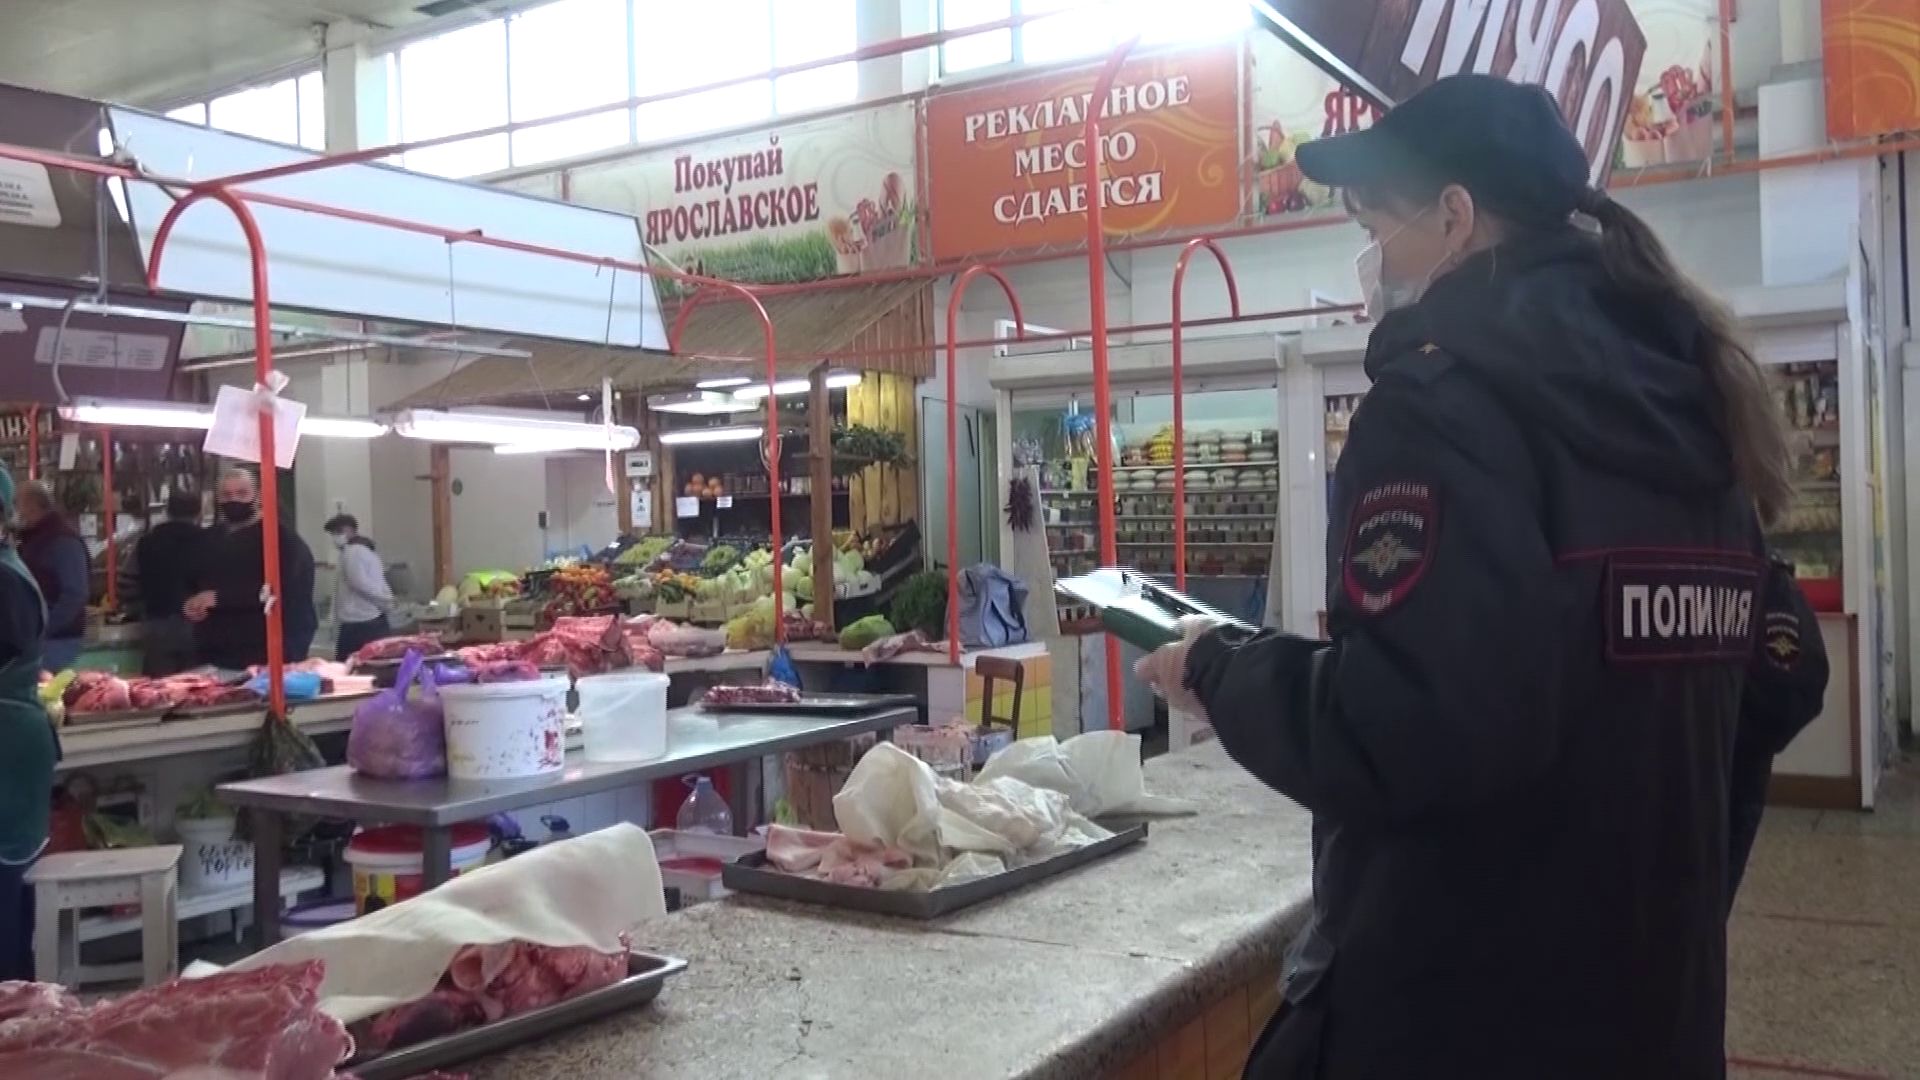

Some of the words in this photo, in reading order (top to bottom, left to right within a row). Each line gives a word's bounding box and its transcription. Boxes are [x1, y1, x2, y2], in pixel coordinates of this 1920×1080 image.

[674, 135, 784, 195] Покупай
[1015, 132, 1137, 177] МЕСТО
[646, 182, 820, 246] ЯРОСЛАВСКОЕ
[993, 171, 1163, 227] СДАЕТСЯ
[1362, 482, 1430, 505] ПОЛИЦИЯ
[1358, 509, 1425, 536] РОССИЯ
[1622, 584, 1753, 645] ПОЛИЦИЯ
